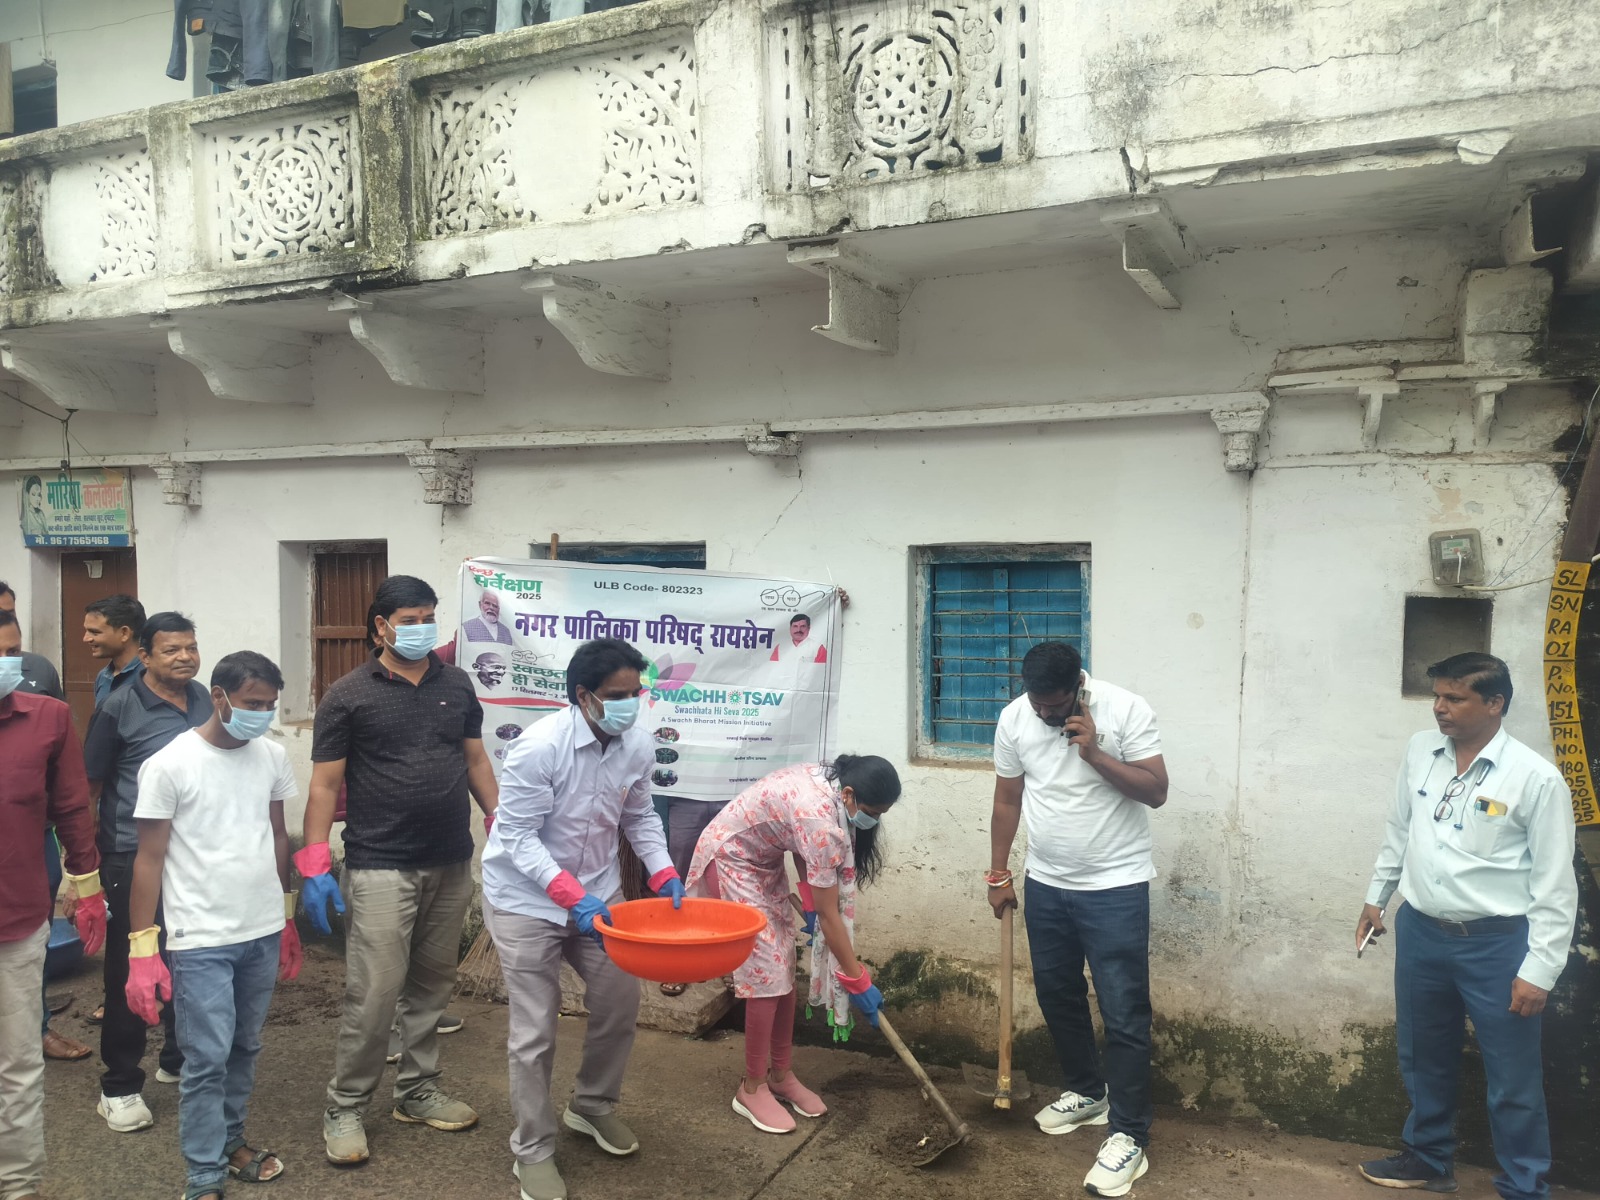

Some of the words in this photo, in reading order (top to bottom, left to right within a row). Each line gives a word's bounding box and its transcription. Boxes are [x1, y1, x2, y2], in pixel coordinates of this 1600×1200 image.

[473, 573, 543, 593] सर्वेक्षण
[1557, 569, 1581, 586] SL
[594, 581, 619, 590] ULB
[623, 582, 659, 592] Code-
[661, 585, 703, 595] 802323
[516, 592, 541, 600] 2025
[514, 612, 559, 639] नगर
[564, 610, 640, 642] पालिका
[645, 614, 705, 654] परिषद्
[710, 619, 775, 650] रायसेन
[1548, 618, 1571, 635] RA
[512, 663, 567, 679] स्वच्छत
[1548, 665, 1562, 680] P.
[512, 673, 528, 686] ही
[533, 677, 567, 691] सेवा
[674, 705, 712, 715] Swachhata
[714, 706, 722, 715] Hi
[723, 707, 740, 716] Seva
[741, 708, 759, 717] 2025
[1549, 700, 1574, 721] 151
[1553, 726, 1578, 740] PH.
[1558, 761, 1584, 776] 180
[1572, 797, 1592, 811] 25
[1574, 810, 1595, 824] 25
